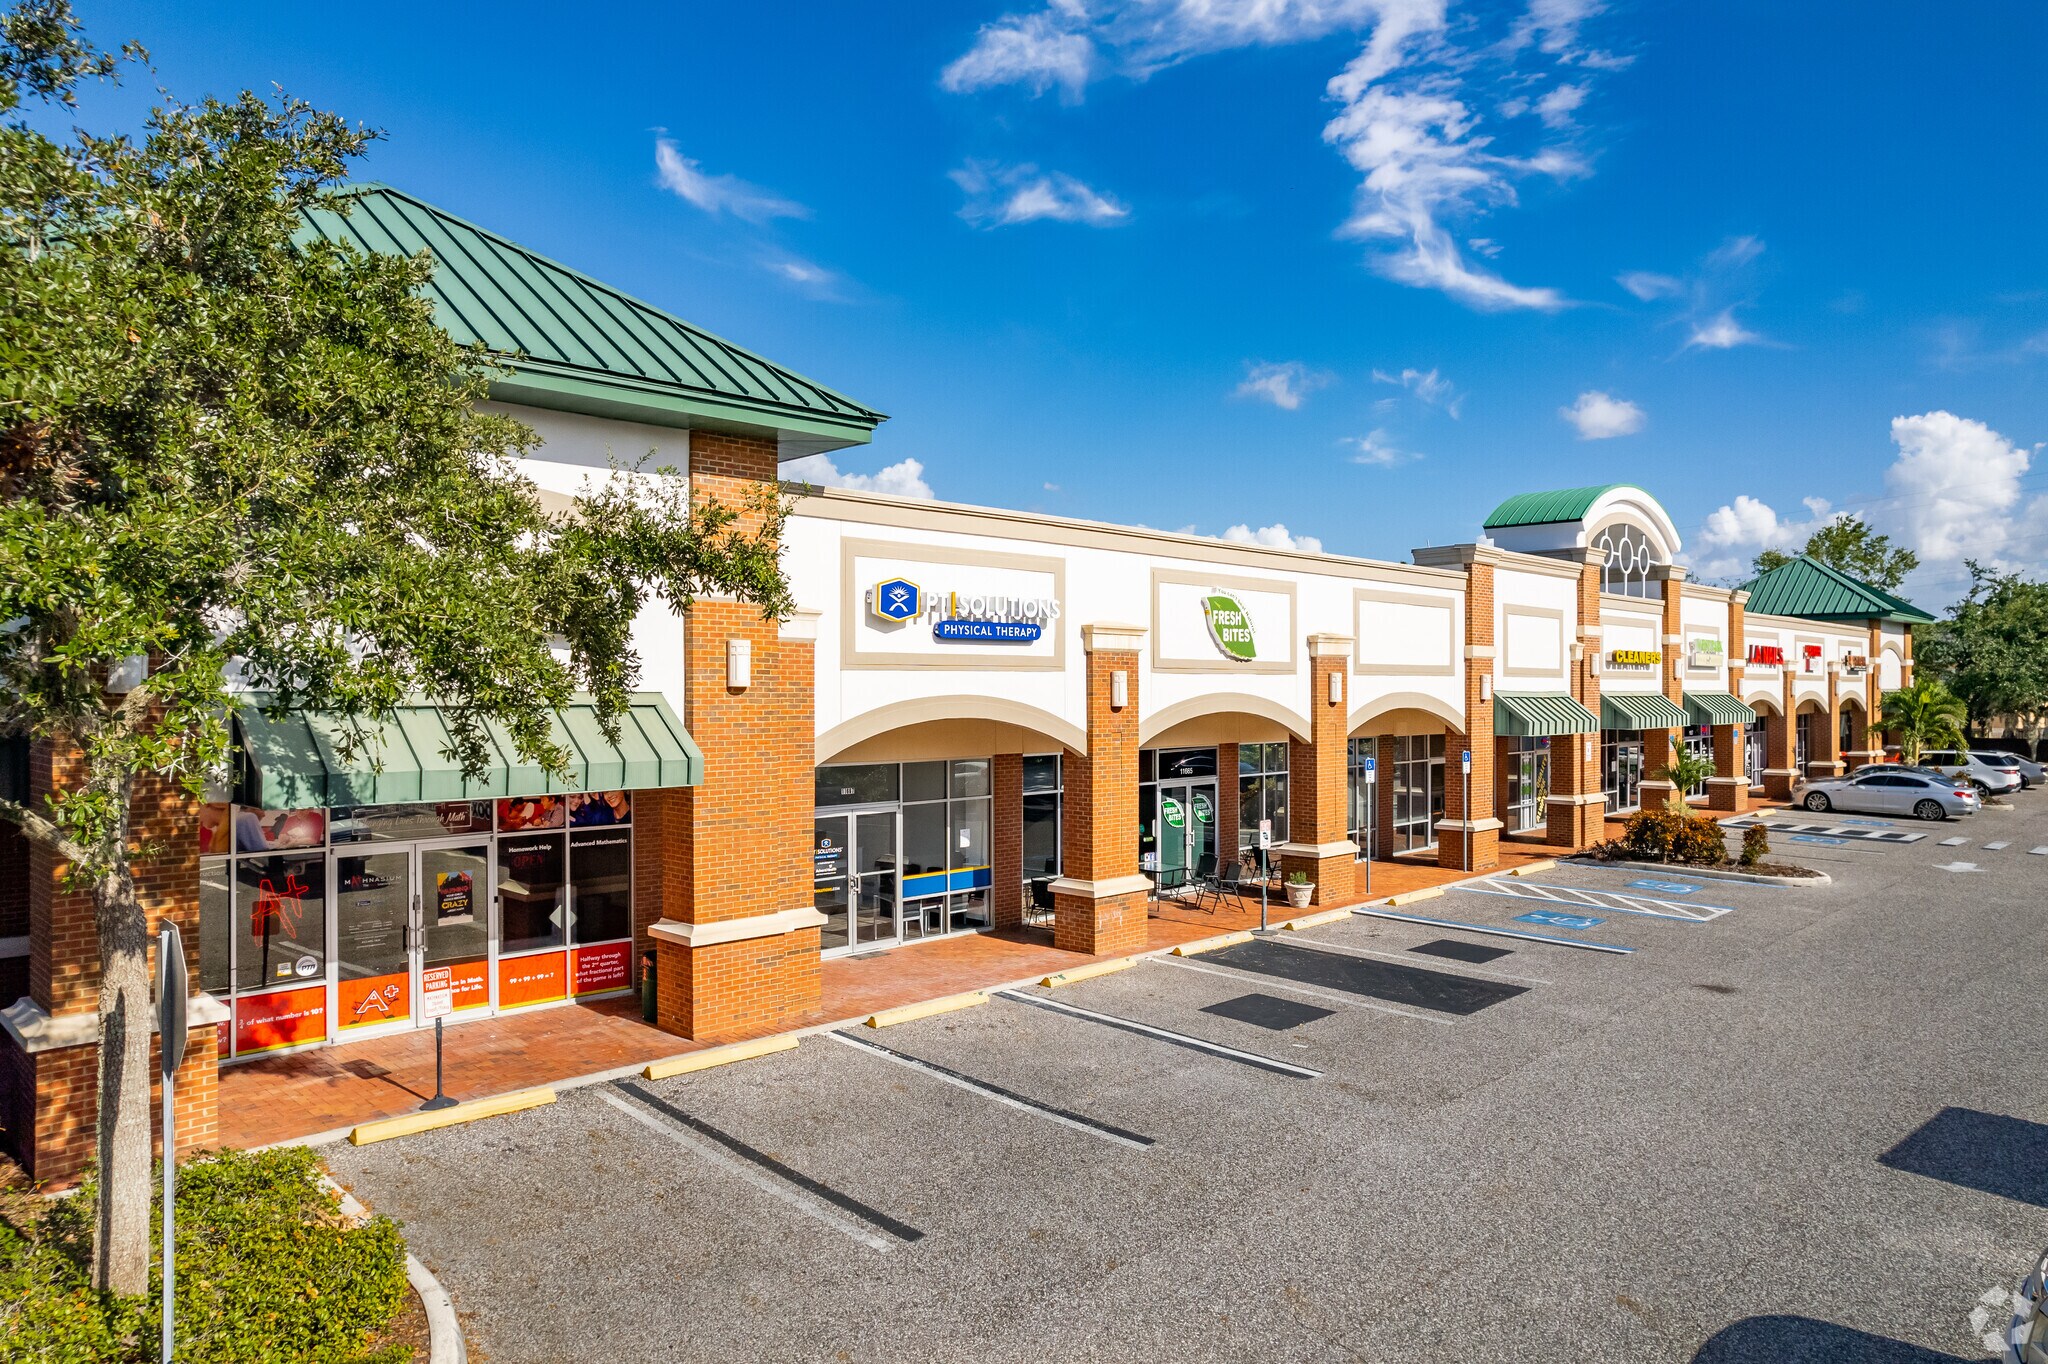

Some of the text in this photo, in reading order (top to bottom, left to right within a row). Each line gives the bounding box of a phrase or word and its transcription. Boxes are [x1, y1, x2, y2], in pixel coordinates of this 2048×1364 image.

[956, 594, 1061, 620] SOLUTIONS
[1212, 610, 1242, 626] FRESH
[944, 624, 1038, 638] PHYSICAL THERAPY
[1222, 628, 1251, 643] BITES
[1614, 649, 1661, 665] CLEANERS
[508, 845, 539, 853] Homework
[570, 838, 628, 848] Advanced Mathematics
[441, 899, 469, 909] CRAZY
[601, 952, 622, 960] through
[423, 970, 449, 983] RESERVED
[575, 965, 624, 977] what fractional part
[592, 975, 607, 983] game
[612, 971, 625, 979] left?
[425, 980, 448, 991] PARKING
[466, 976, 484, 984] Math.
[471, 983, 483, 991] Life.
[255, 1015, 274, 1025] what
[275, 1011, 302, 1021] number
[310, 1007, 324, 1016] 10?
